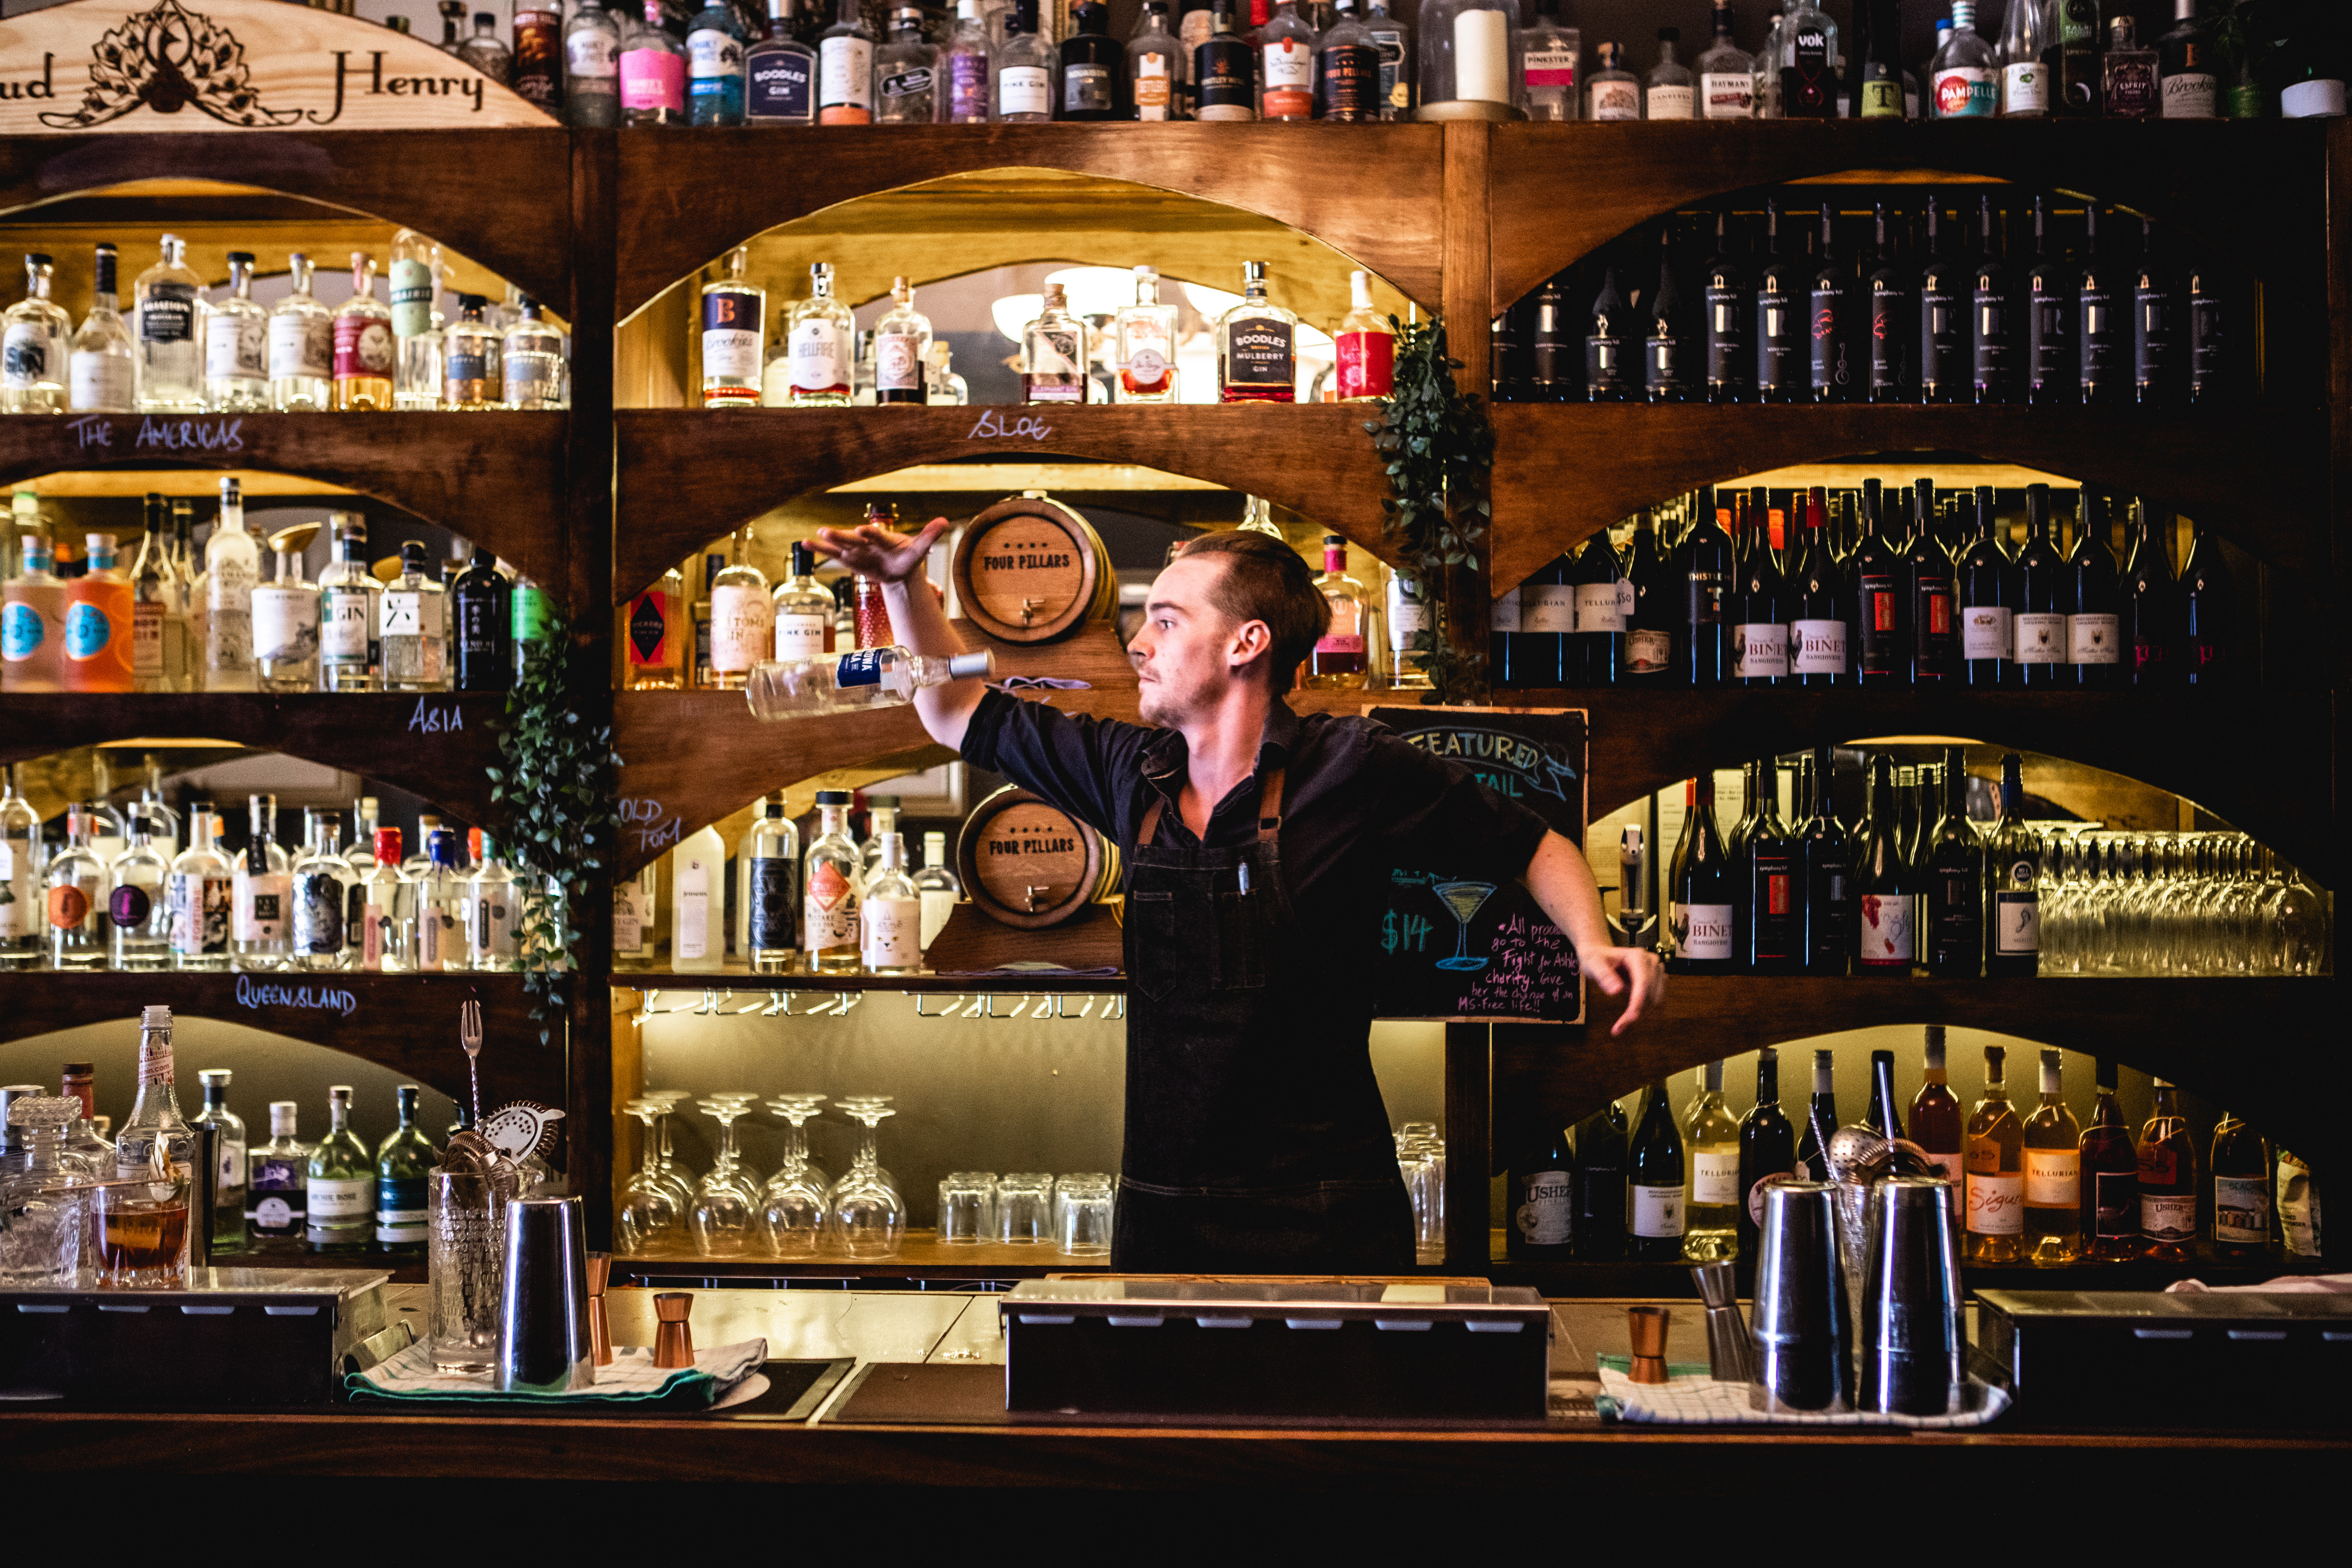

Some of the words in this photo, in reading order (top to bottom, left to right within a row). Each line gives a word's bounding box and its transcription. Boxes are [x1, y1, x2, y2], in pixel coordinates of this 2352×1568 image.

[1798, 32, 1825, 48] vok
[1527, 55, 1570, 64] PINKSTER
[2185, 43, 2203, 67] B
[754, 68, 808, 83] BOODLES
[306, 50, 484, 124] Henry
[768, 86, 791, 96] GIN
[1941, 86, 1997, 102] PAMPELLE
[2119, 82, 2147, 90] ESPRIT
[717, 298, 734, 323] B
[1235, 335, 1287, 348] BOODLES
[1236, 352, 1285, 362] MULBERRY
[967, 409, 1053, 441] SLOE
[65, 414, 112, 449] THE
[135, 414, 245, 453] AMERICAS
[984, 555, 1014, 571] FOUR
[1019, 555, 1070, 570] PILLARS
[1688, 572, 1723, 581] THISTLE
[1584, 599, 1617, 608] TELLUR
[338, 606, 365, 622] GIN
[1749, 643, 1788, 656] BINET
[1805, 640, 1846, 652] BINET
[408, 695, 464, 734] ASIA
[618, 798, 663, 828] OLD
[629, 815, 681, 853] TOM
[989, 840, 1019, 855] FOUR
[1024, 838, 1075, 854] PILLARS
[1380, 909, 1434, 955] $14
[1692, 925, 1732, 938] BINET
[1491, 937, 1506, 951] go
[1508, 937, 1526, 948] to
[1535, 937, 1560, 951] the
[1501, 947, 1535, 972] Fight
[236, 974, 356, 1018] QUEENSLAND
[1471, 984, 1488, 998] her
[1493, 985, 1508, 999] the
